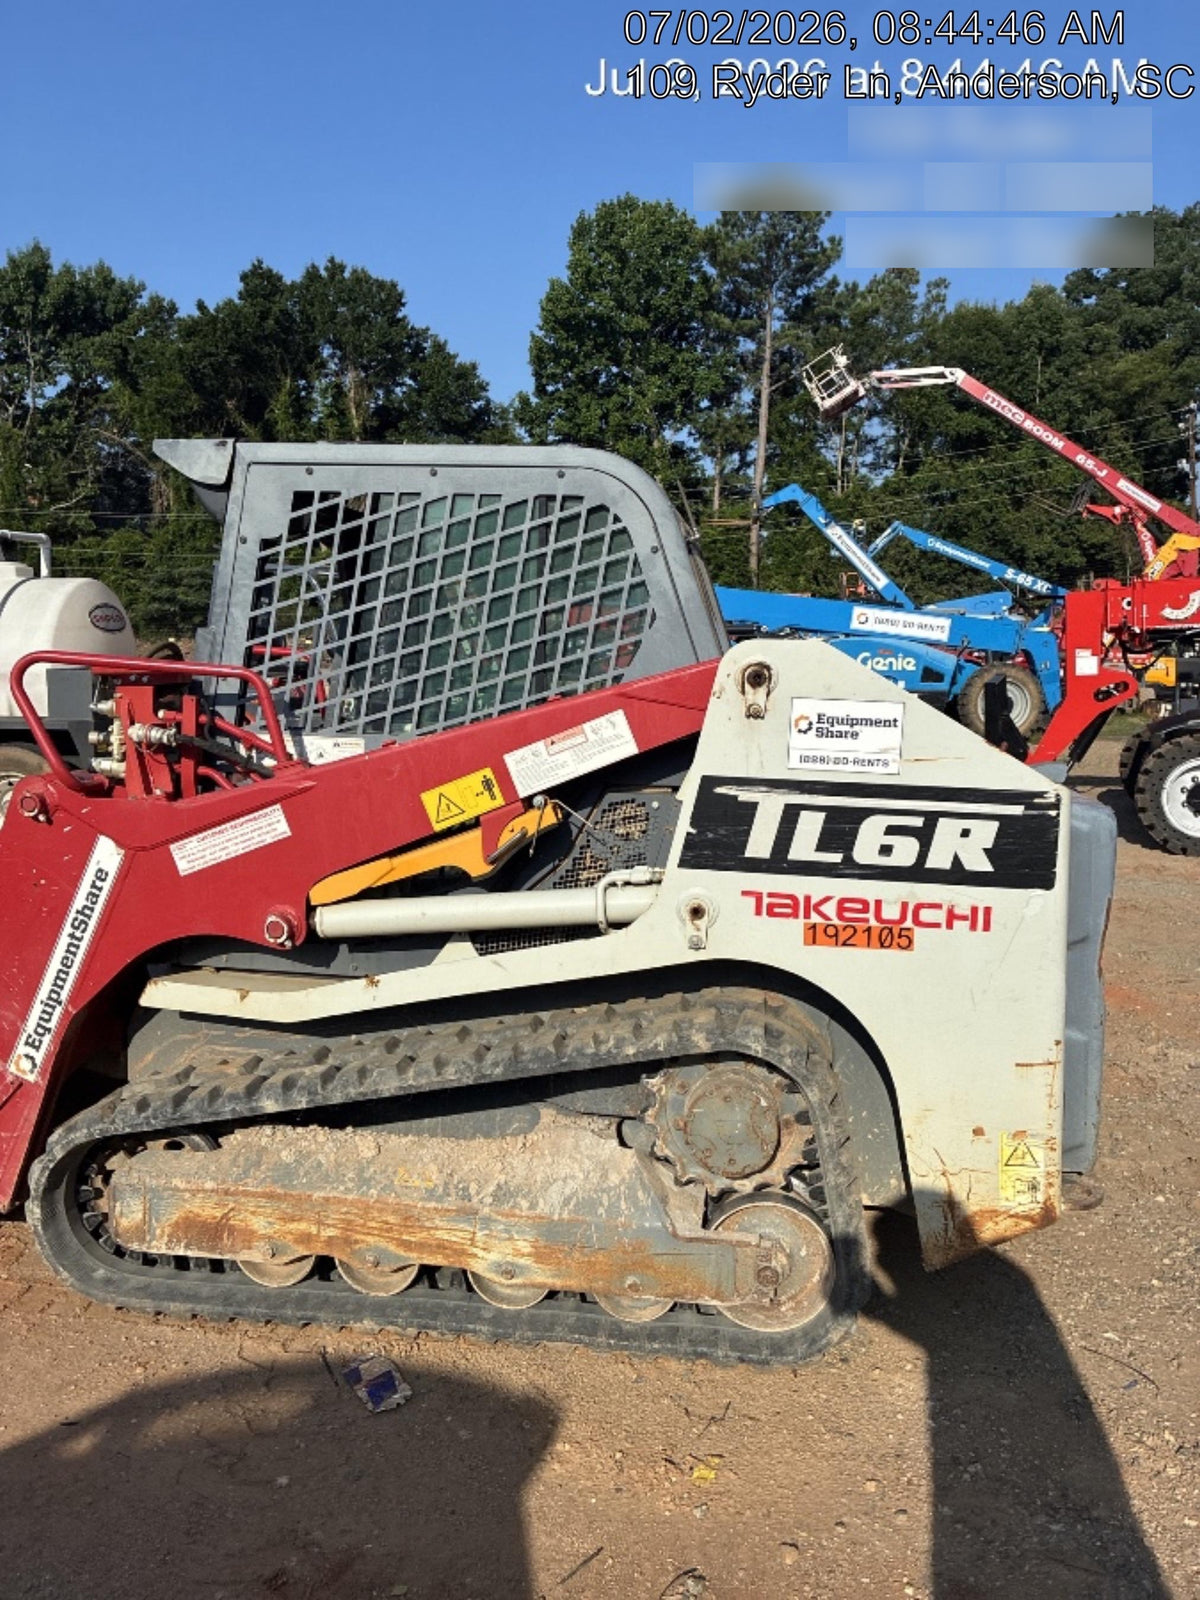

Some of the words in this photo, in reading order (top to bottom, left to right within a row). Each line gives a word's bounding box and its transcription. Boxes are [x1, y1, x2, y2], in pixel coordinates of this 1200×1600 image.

[1023, 418, 1066, 451] BOOM
[1003, 568, 1035, 587] S-65
[856, 652, 917, 671] Genie
[815, 713, 899, 728] Equipment
[815, 726, 860, 741] Share
[737, 794, 1001, 872] TL6R
[806, 922, 914, 950] 192105
[24, 865, 110, 1052] EquipmentShare
